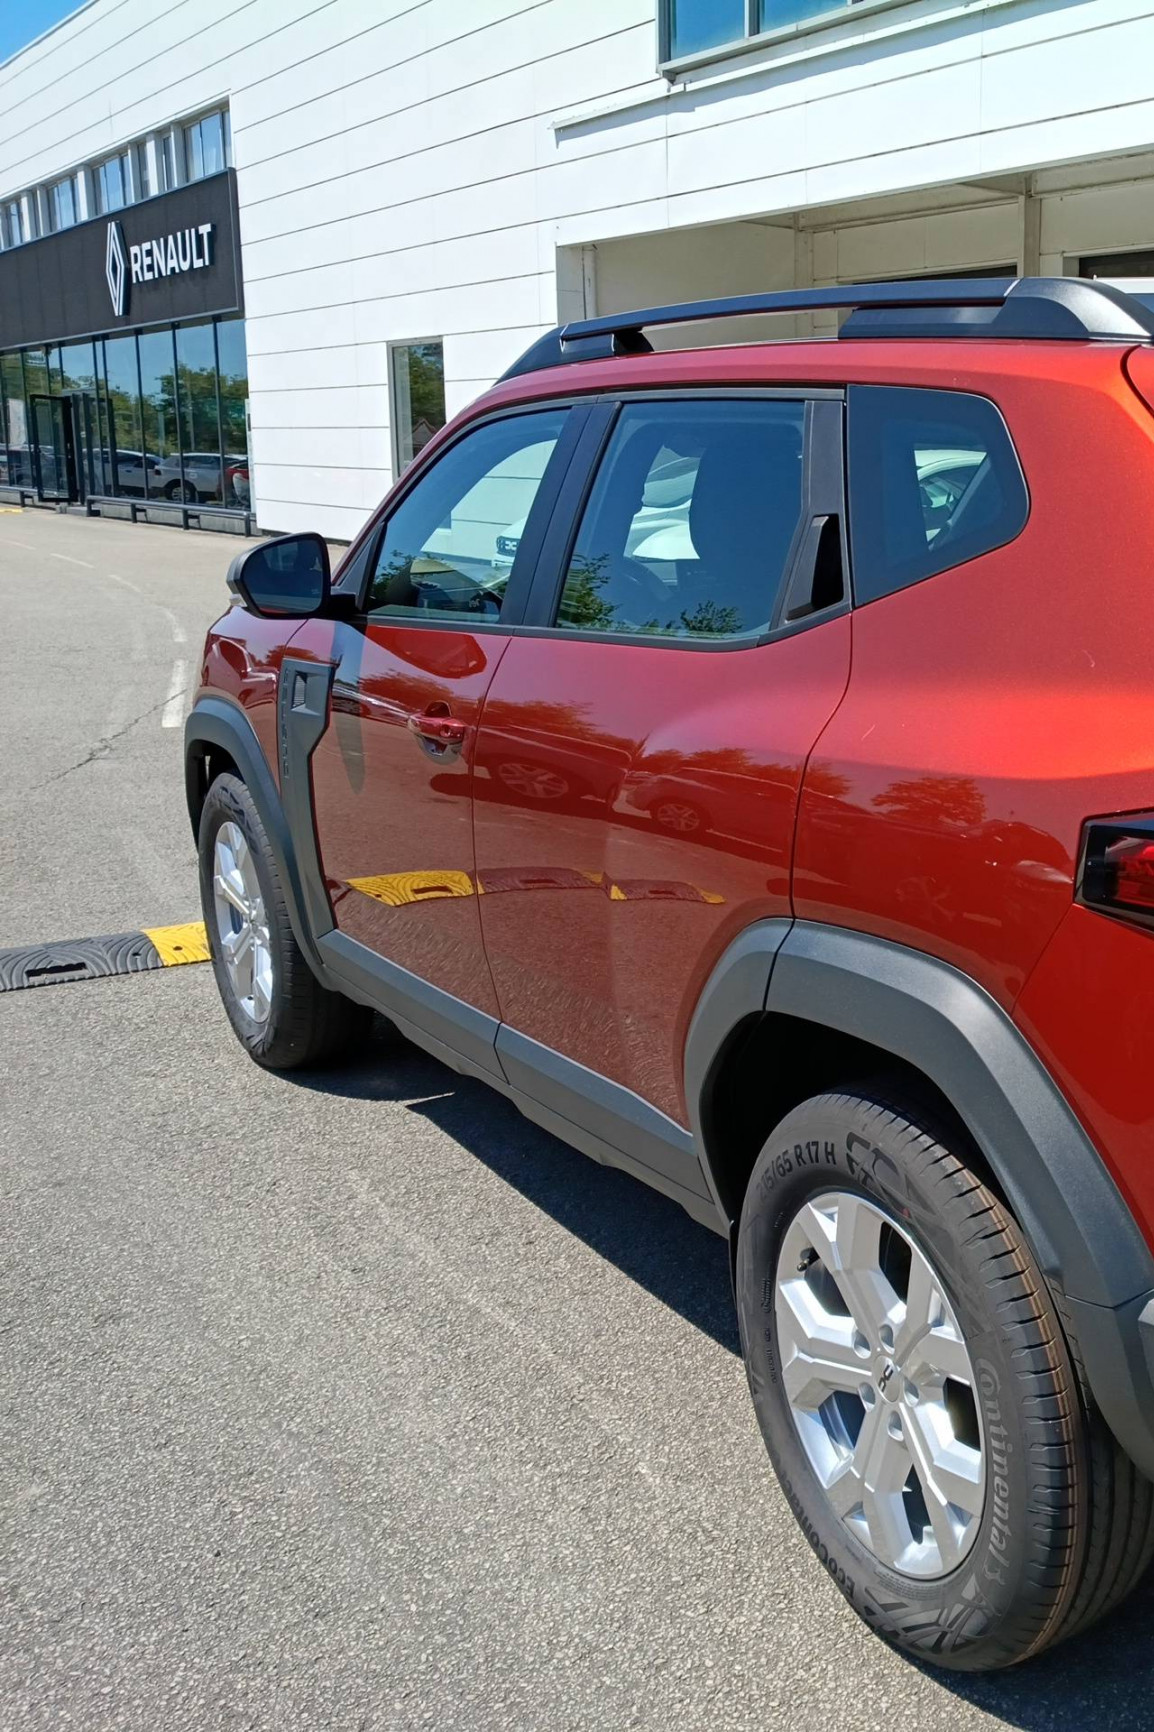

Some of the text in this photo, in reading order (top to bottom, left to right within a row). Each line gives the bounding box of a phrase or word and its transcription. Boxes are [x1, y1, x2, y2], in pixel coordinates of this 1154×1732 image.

[129, 223, 212, 284] RENAULT
[794, 1144, 807, 1167] R
[806, 1141, 820, 1164] 17
[824, 1140, 837, 1166] H
[974, 1357, 1013, 1568] Continental
